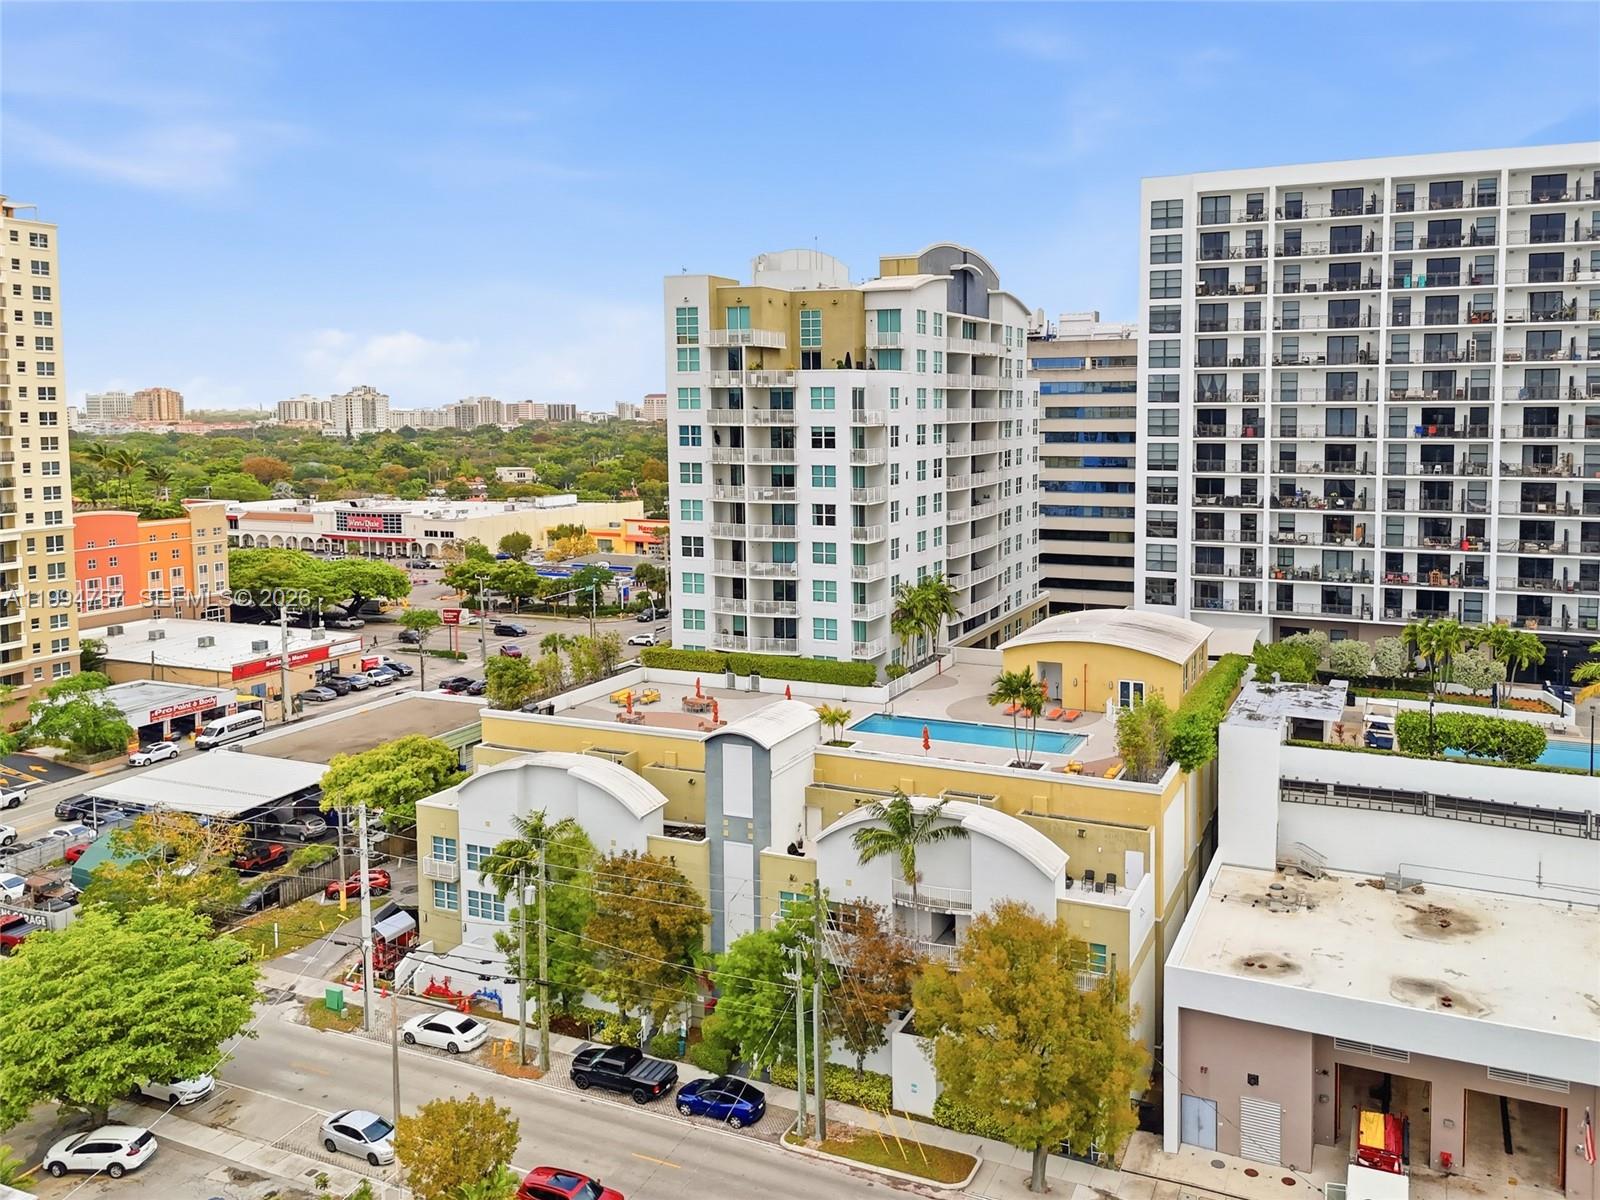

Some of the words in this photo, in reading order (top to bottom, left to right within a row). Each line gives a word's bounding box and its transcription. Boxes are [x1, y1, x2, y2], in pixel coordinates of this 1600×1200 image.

[154, 707, 173, 716] Pro
[173, 702, 192, 711] Paint
[198, 696, 216, 705] Body
